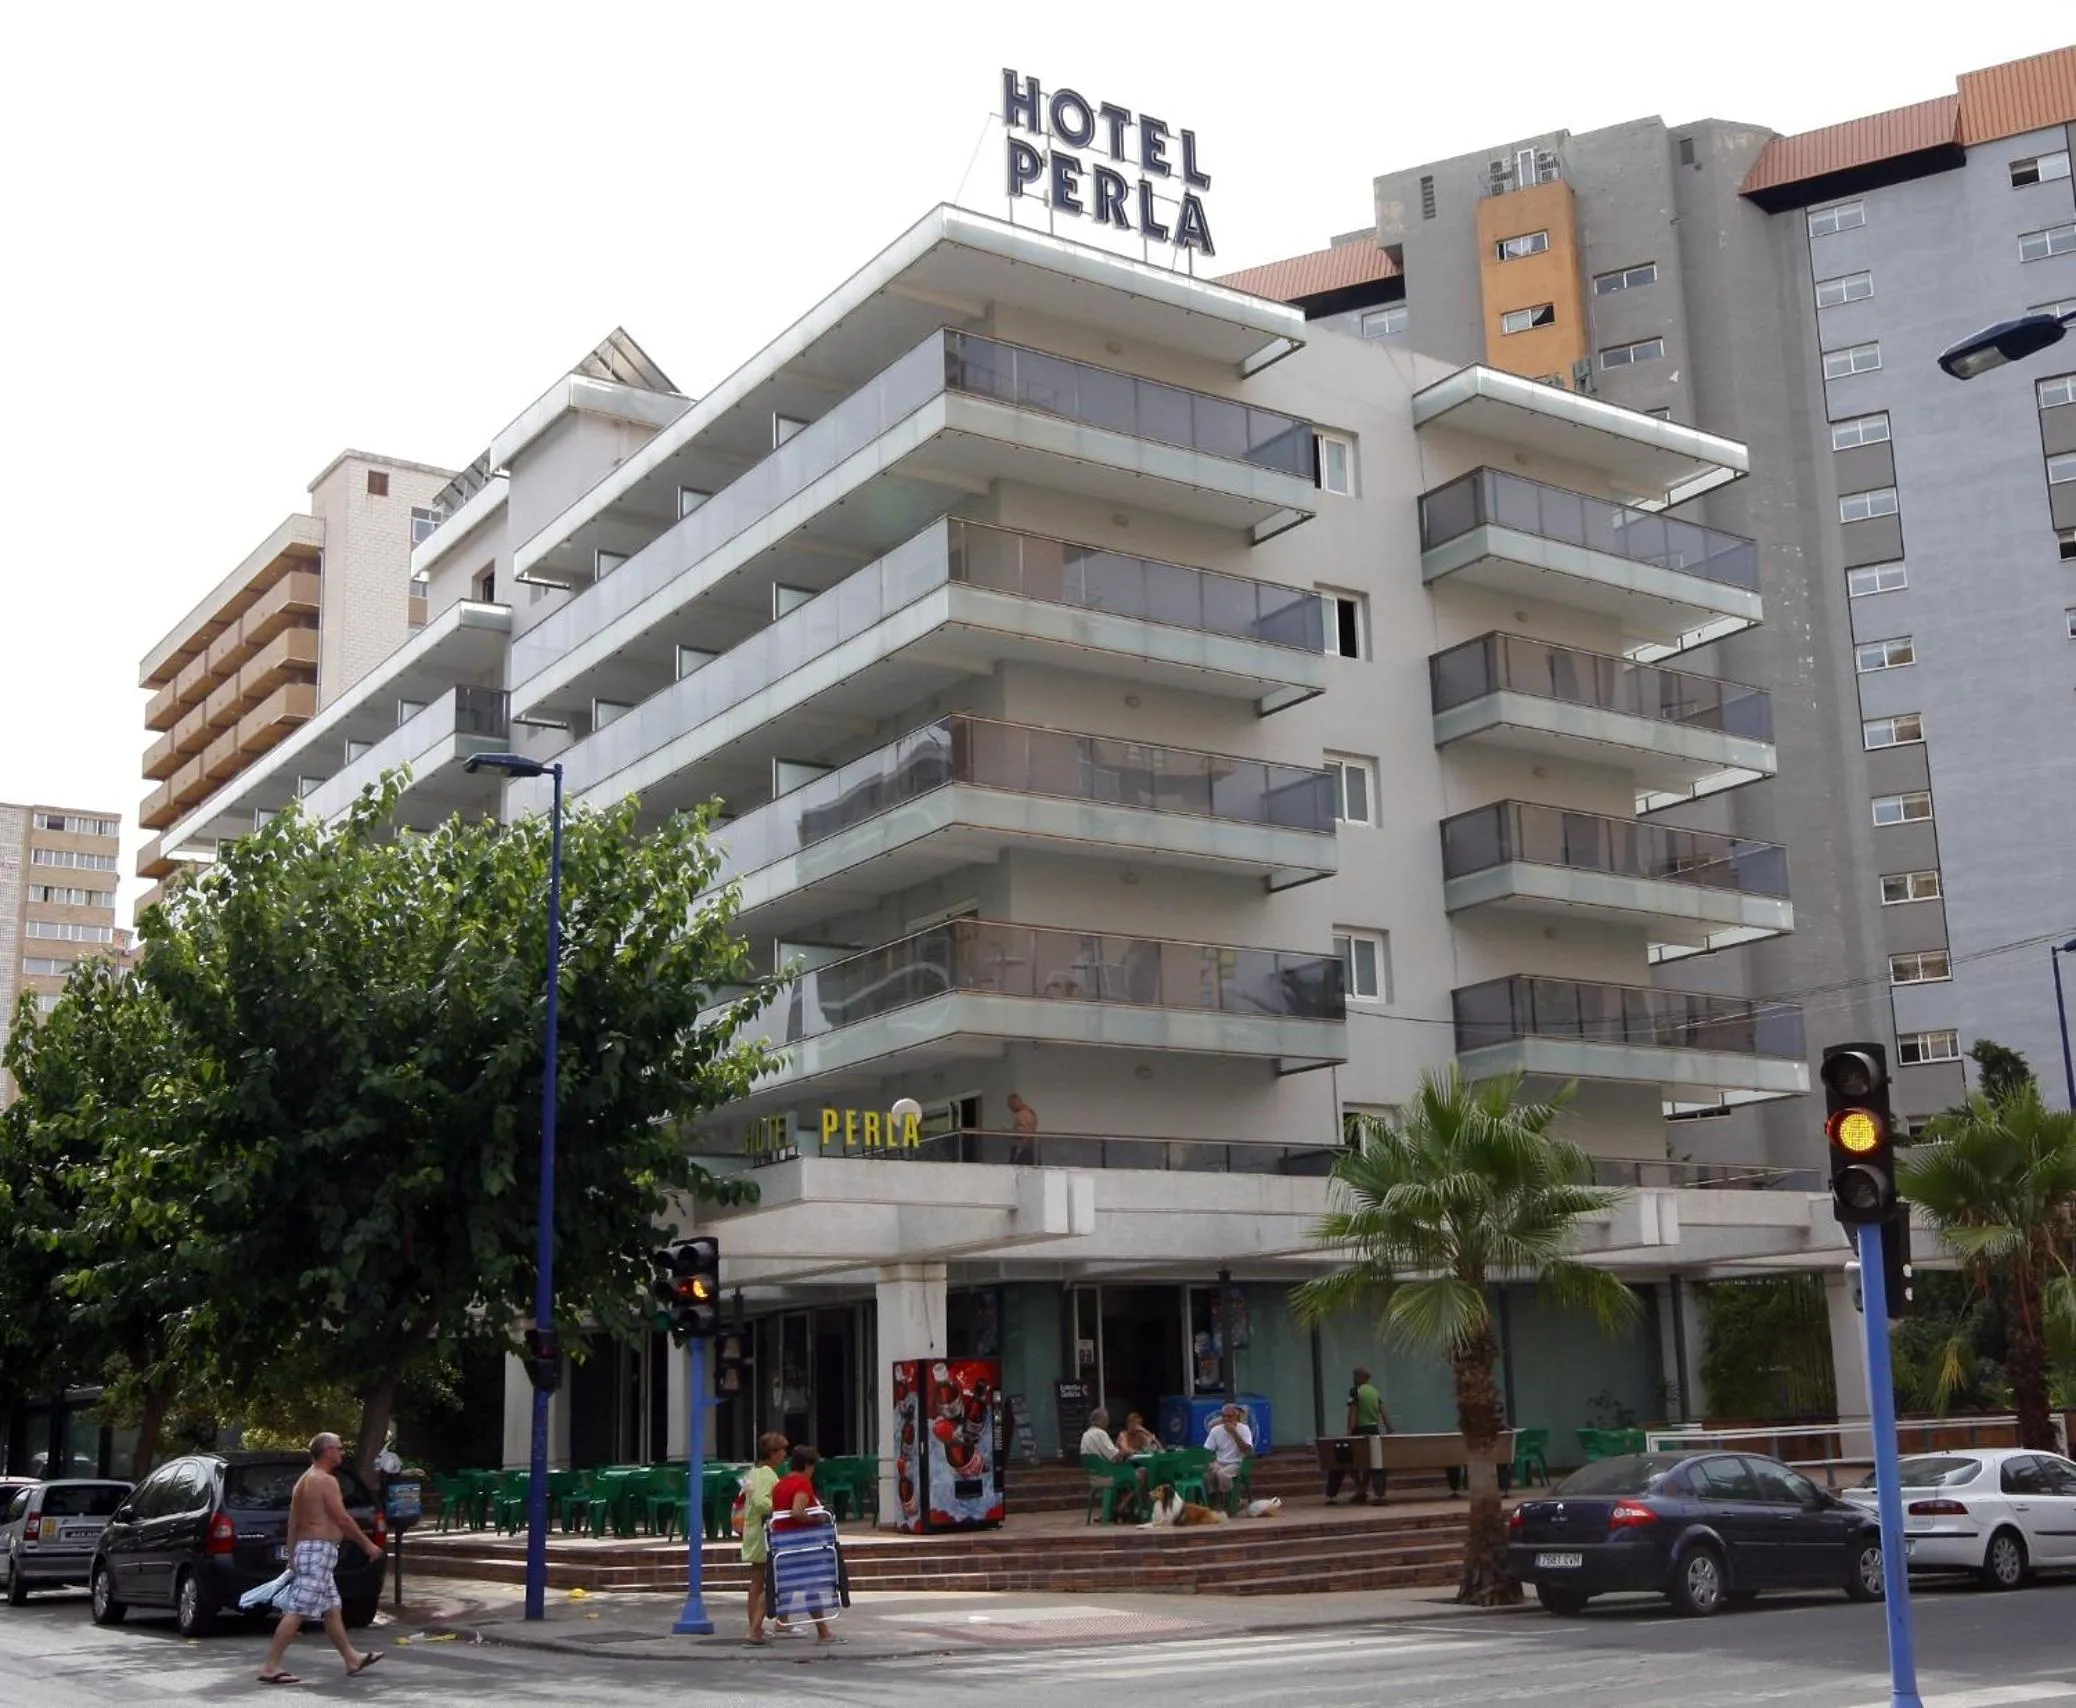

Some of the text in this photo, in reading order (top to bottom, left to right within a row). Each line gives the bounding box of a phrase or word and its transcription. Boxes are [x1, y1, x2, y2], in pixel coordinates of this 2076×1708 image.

[1002, 67, 1211, 192] HOTEL
[1006, 135, 1216, 257] PERLA
[821, 1106, 920, 1149] PERLA
